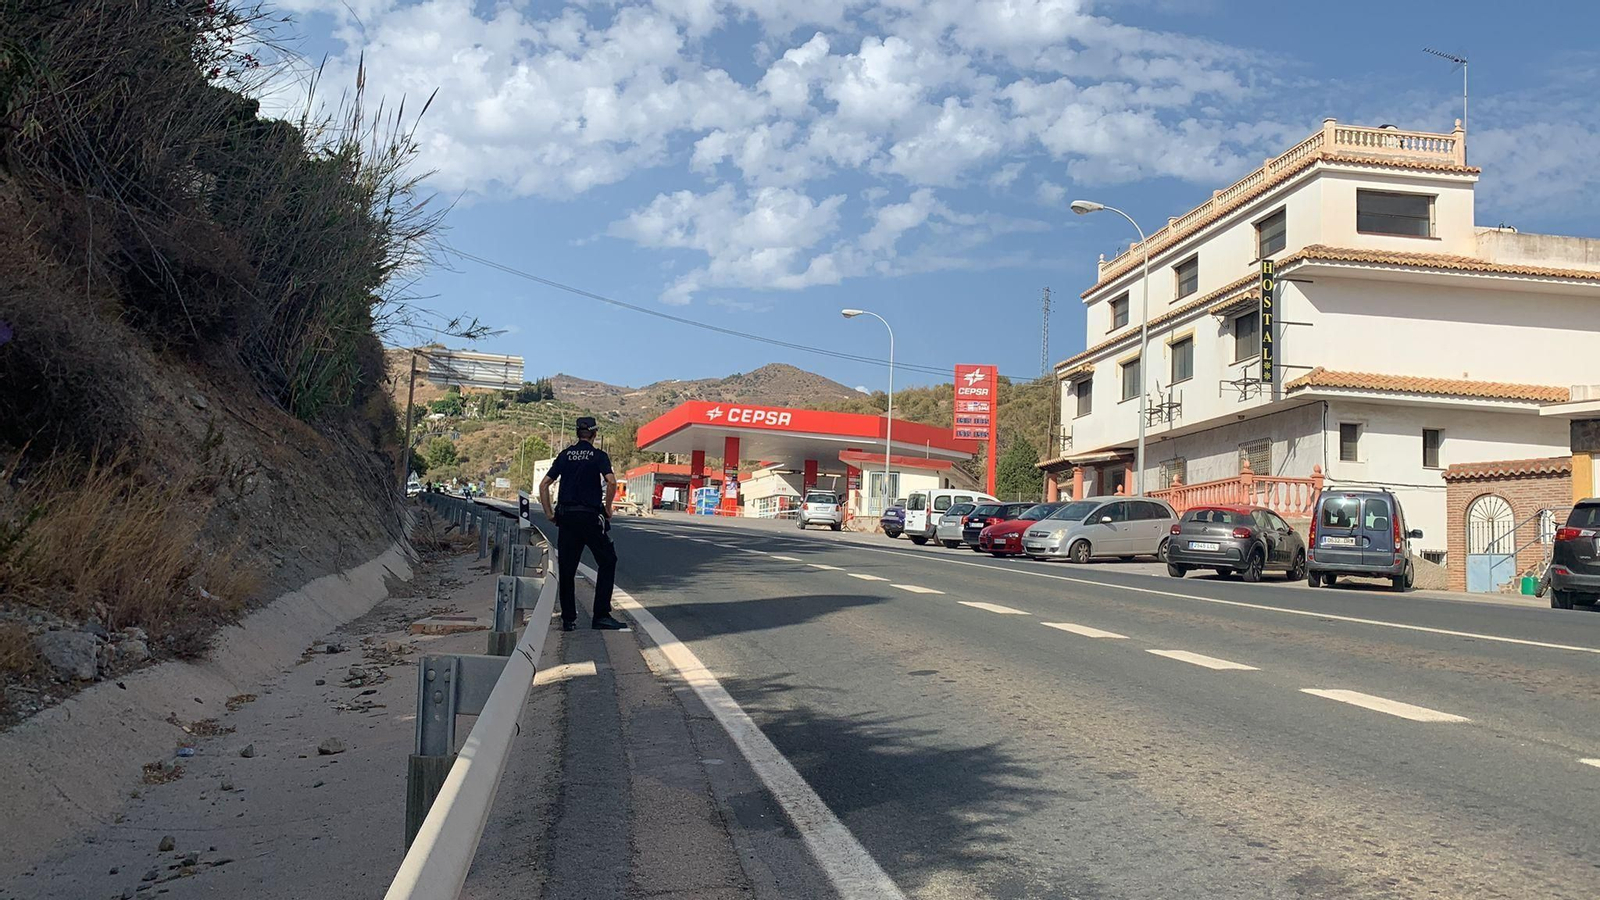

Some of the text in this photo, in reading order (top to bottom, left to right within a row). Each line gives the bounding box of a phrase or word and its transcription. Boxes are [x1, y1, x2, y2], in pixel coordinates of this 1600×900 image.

[1262, 262, 1273, 360] HOSTAL
[958, 387, 989, 396] CEPSA
[727, 407, 792, 426] CEPSA
